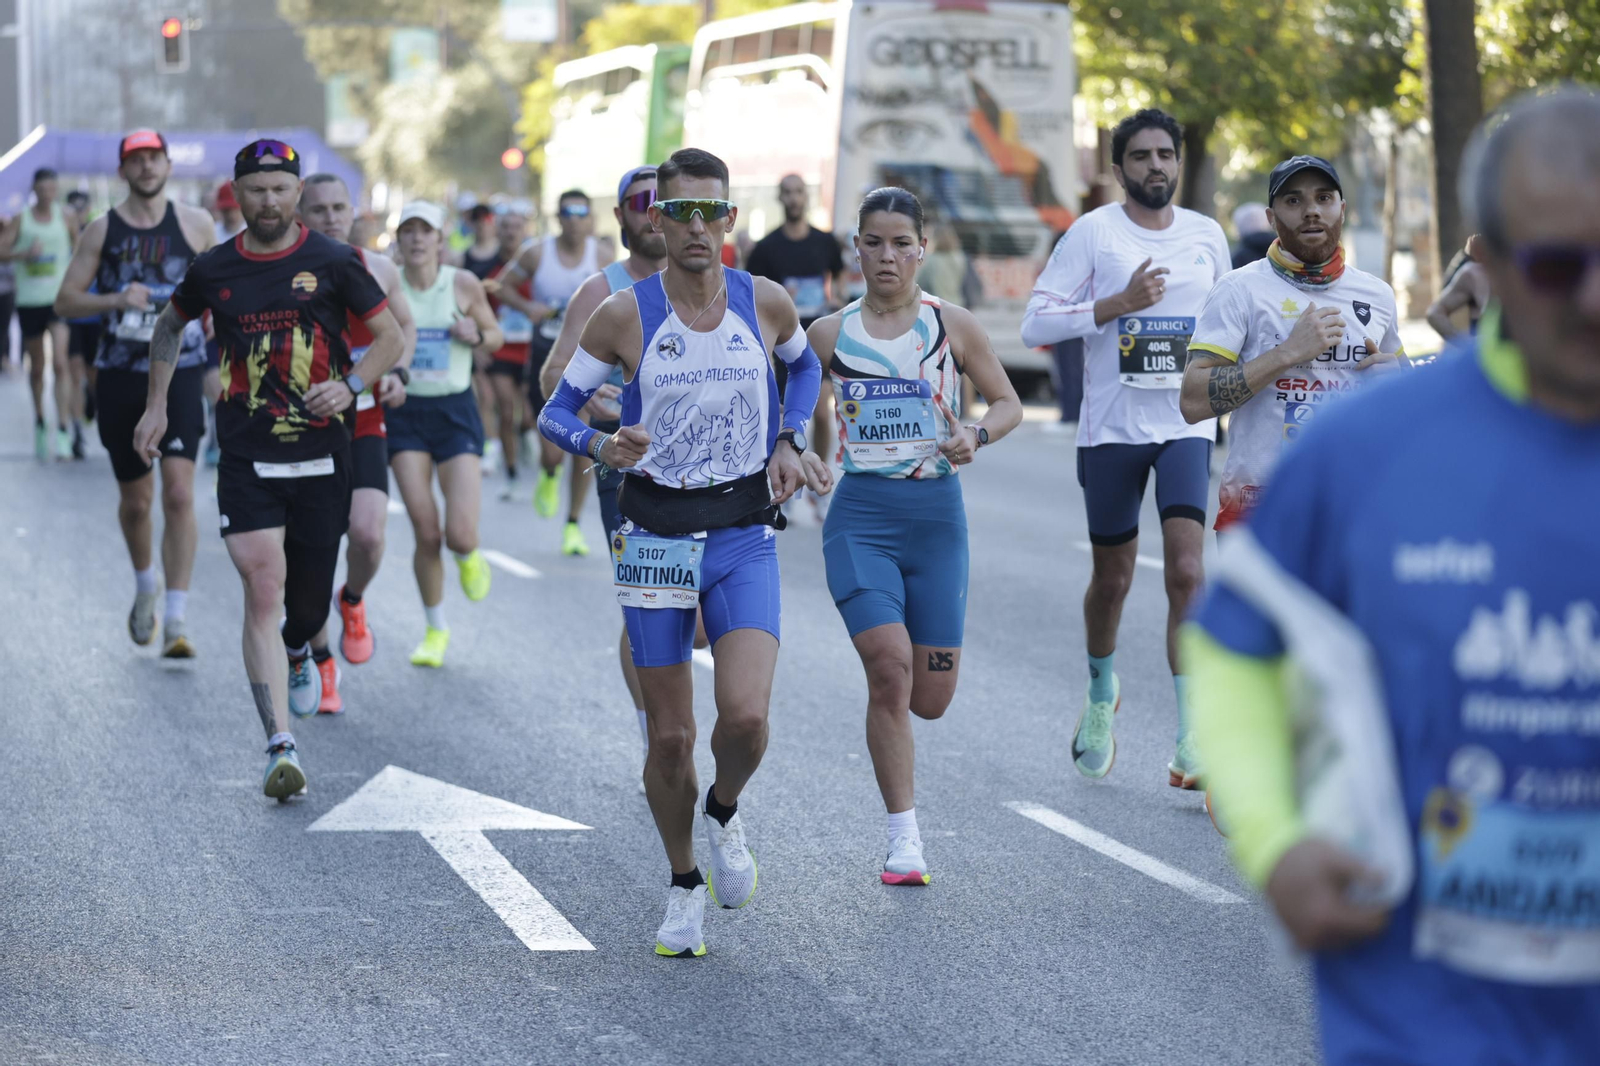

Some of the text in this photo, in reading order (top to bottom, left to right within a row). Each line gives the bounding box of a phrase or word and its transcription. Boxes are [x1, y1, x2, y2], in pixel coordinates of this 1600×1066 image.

[868, 34, 1051, 70] GODSPELL
[1147, 341, 1172, 352] 4045
[1143, 355, 1176, 371] LUIS
[705, 367, 759, 382] ATLETISMO
[872, 384, 920, 395] ZURICH
[875, 407, 902, 420] 5160
[859, 422, 922, 440] KARIMA
[638, 547, 666, 560] 5107
[617, 563, 695, 587] CONTINÚA
